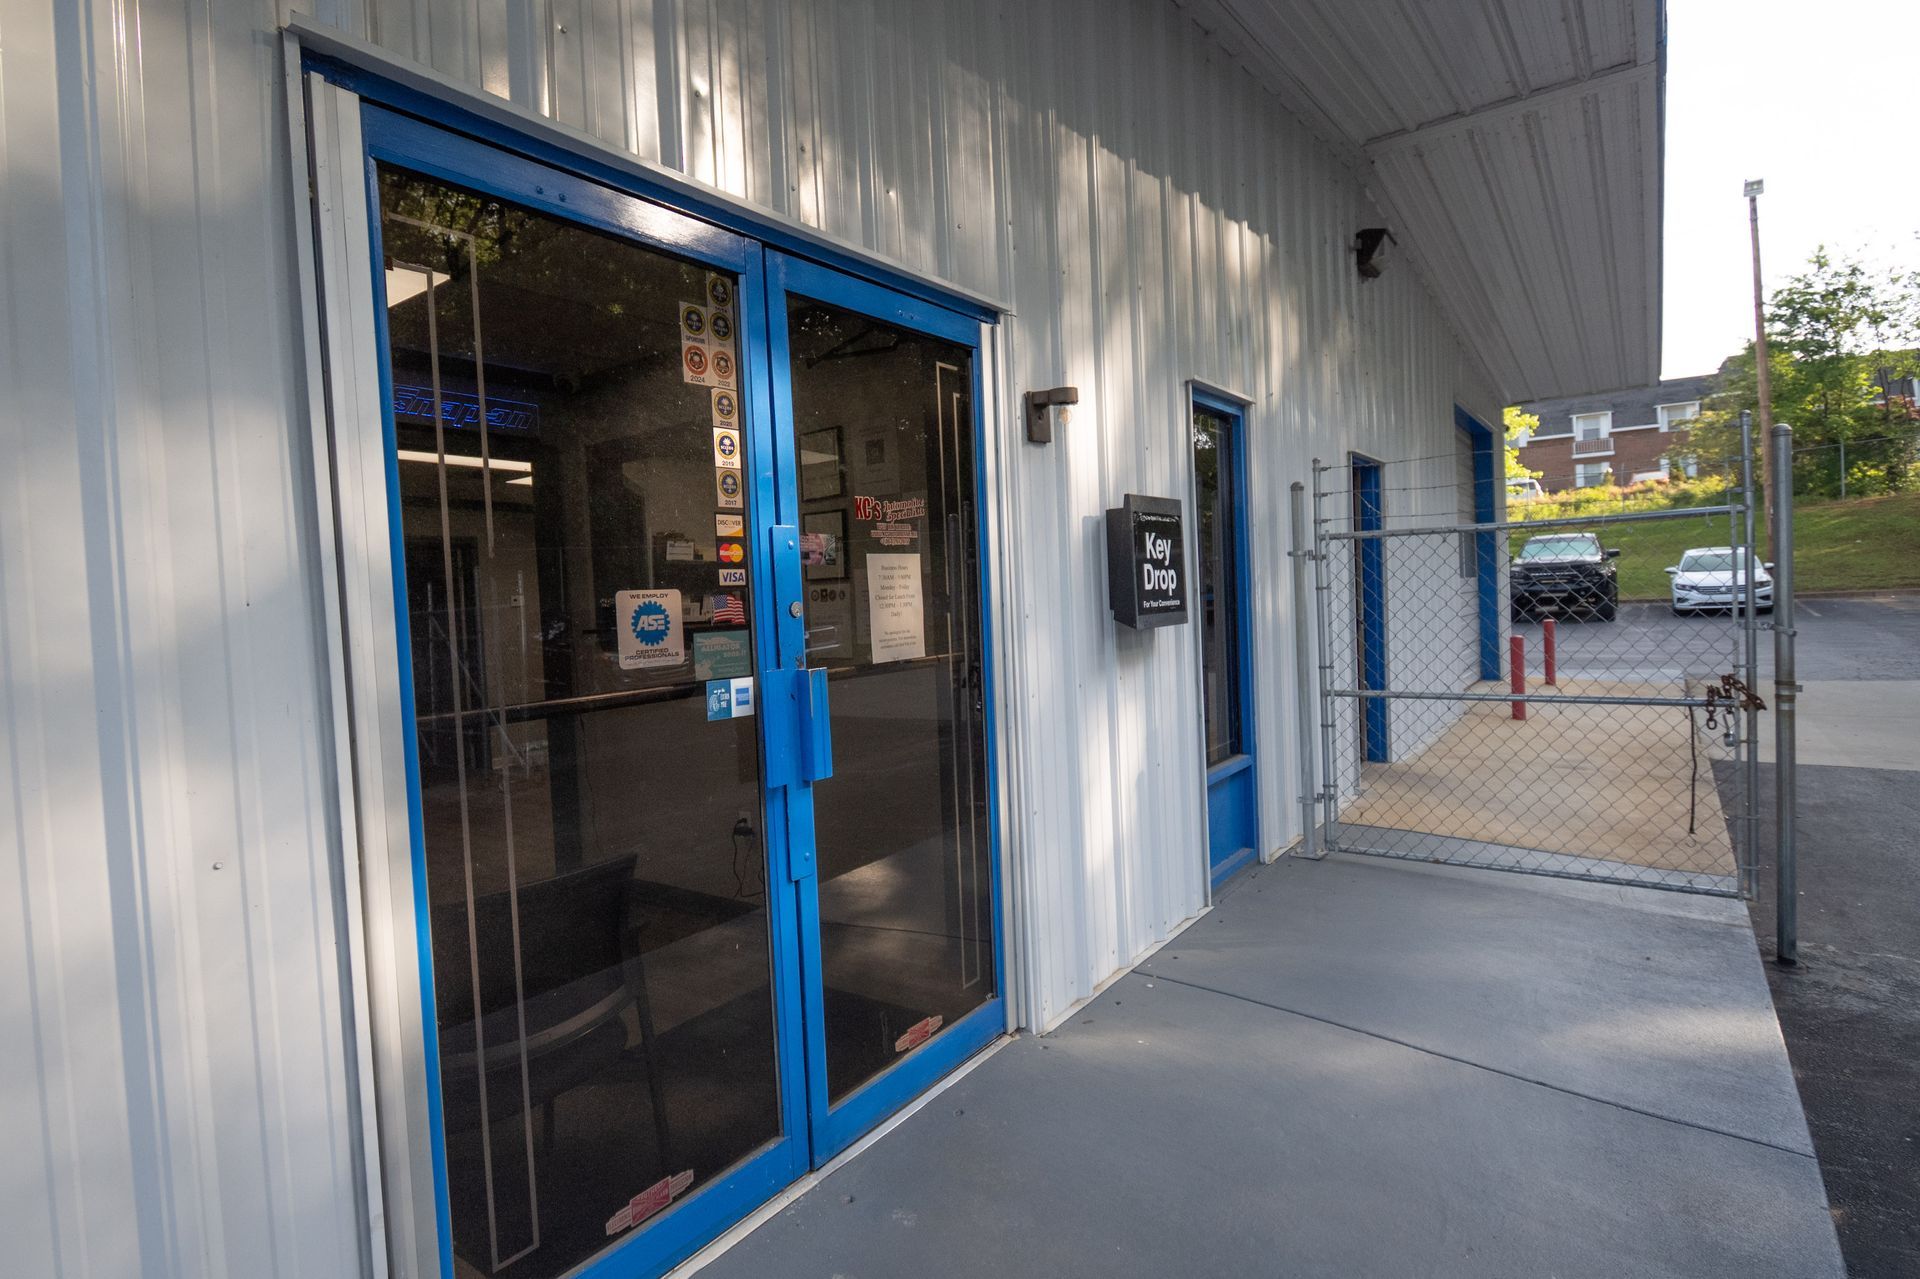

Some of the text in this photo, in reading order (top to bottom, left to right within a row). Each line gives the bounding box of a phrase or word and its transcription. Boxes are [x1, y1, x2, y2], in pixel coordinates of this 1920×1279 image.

[854, 495, 882, 520] KC's
[1145, 532, 1171, 566] Key
[722, 571, 745, 583] VISA
[1143, 563, 1177, 596] Drop
[1143, 600, 1151, 608] For
[1150, 600, 1159, 608] Your
[636, 614, 666, 631] ASE
[624, 651, 680, 661] PROFESSIONALS
